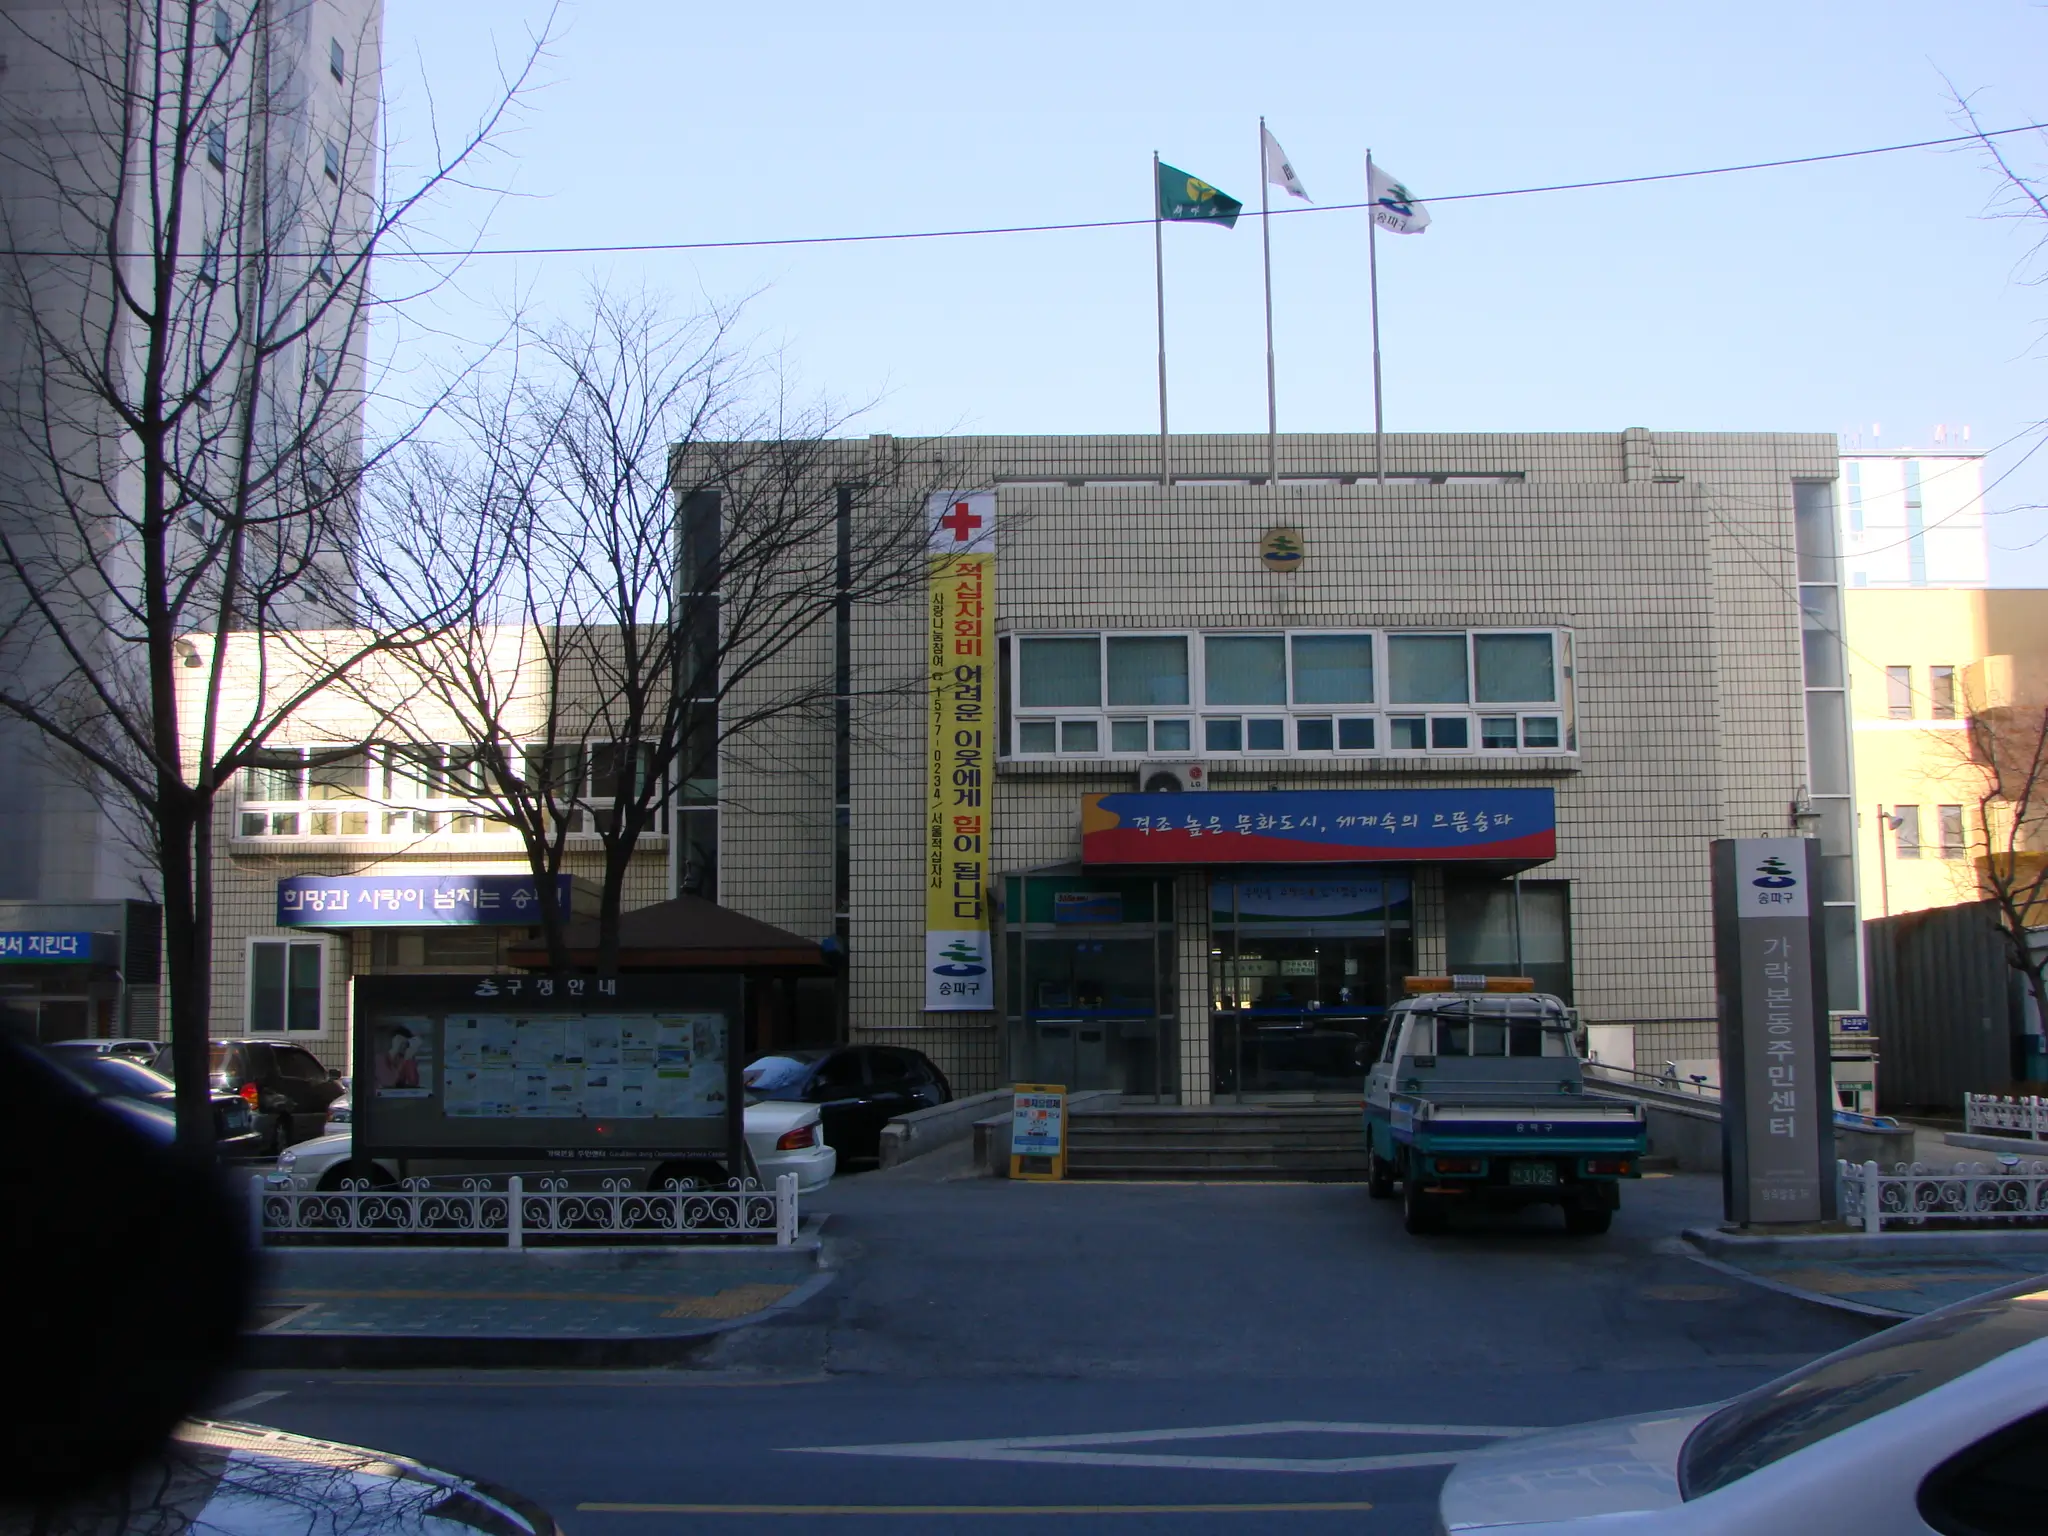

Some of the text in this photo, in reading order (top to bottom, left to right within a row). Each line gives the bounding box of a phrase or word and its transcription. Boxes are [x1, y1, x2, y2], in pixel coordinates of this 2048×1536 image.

[952, 562, 984, 920] 적십자회비 어려운 이웃에게 힘이 됩니다
[1132, 810, 1515, 838] 격조 높은 문화도시, 세계속의 으뜸송파
[283, 887, 562, 911] 희망과 사랑이 넘치는 송!
[1757, 891, 1794, 905] 송파구
[28, 936, 79, 955] 지킨다
[939, 981, 981, 996] 송파구
